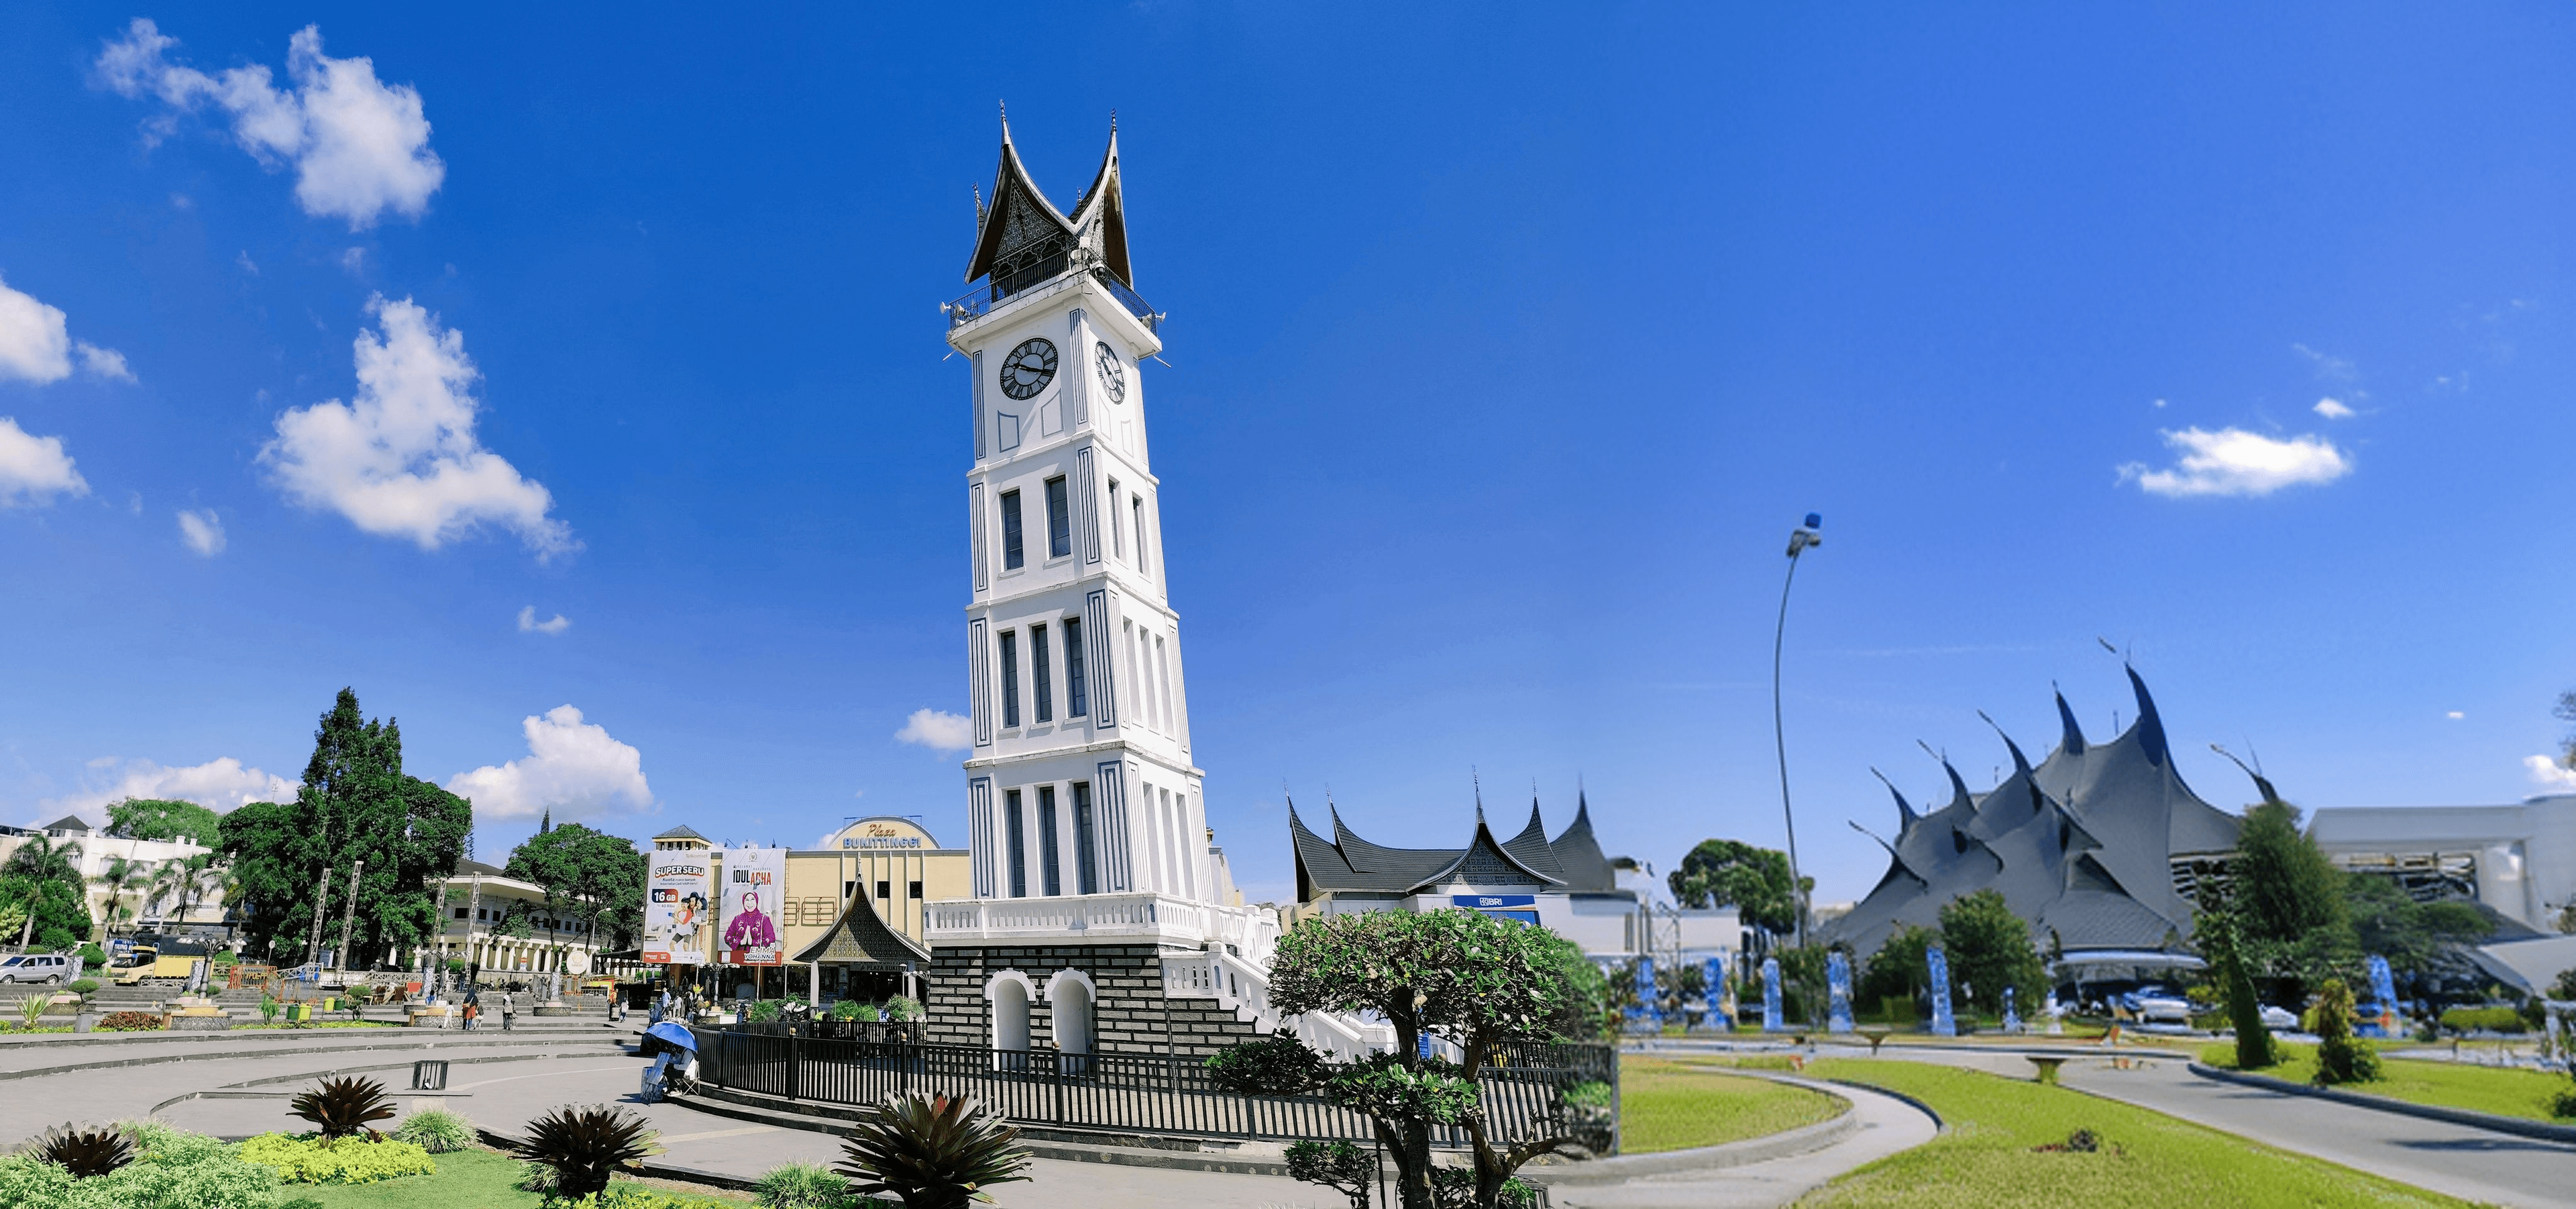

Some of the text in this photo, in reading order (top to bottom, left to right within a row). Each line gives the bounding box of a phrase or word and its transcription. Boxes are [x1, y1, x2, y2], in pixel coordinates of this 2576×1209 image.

[867, 824, 896, 837] Plaza
[843, 837, 922, 849] BUKITTINGGI
[733, 870, 750, 883] IDUL
[654, 891, 665, 902] 16
